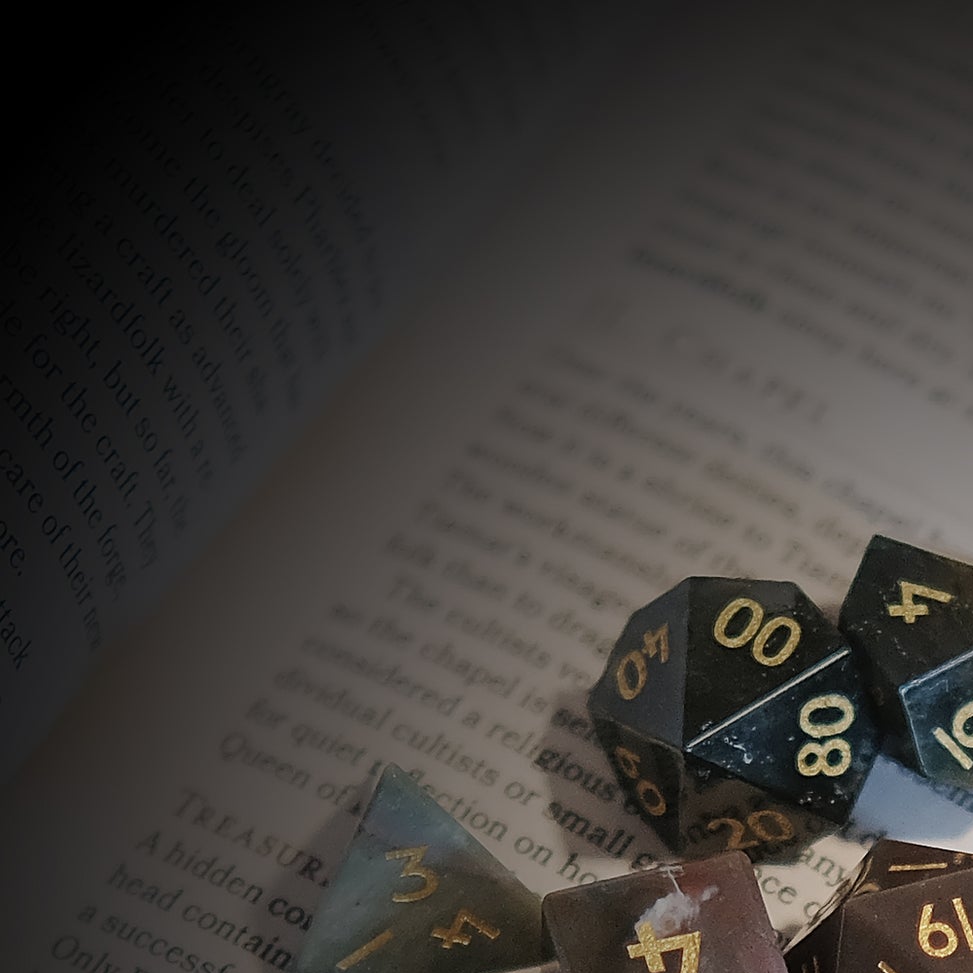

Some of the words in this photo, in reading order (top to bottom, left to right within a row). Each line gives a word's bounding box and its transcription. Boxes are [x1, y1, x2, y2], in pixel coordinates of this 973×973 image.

[116, 237, 173, 305] craft
[57, 232, 165, 376] lizardfolk
[163, 375, 200, 438] with
[38, 286, 100, 369] right,
[103, 359, 140, 415] but
[134, 417, 158, 452] so
[24, 333, 63, 379] for
[61, 382, 97, 433] the
[96, 435, 139, 508] craft.
[52, 450, 85, 481] of
[72, 479, 103, 529] the
[58, 542, 95, 606] their
[888, 581, 953, 624] 4
[391, 722, 501, 788] cultists
[542, 793, 638, 861] small
[706, 810, 793, 850] 20
[109, 865, 185, 912] head
[166, 841, 265, 906] hidden
[384, 847, 440, 902] 3
